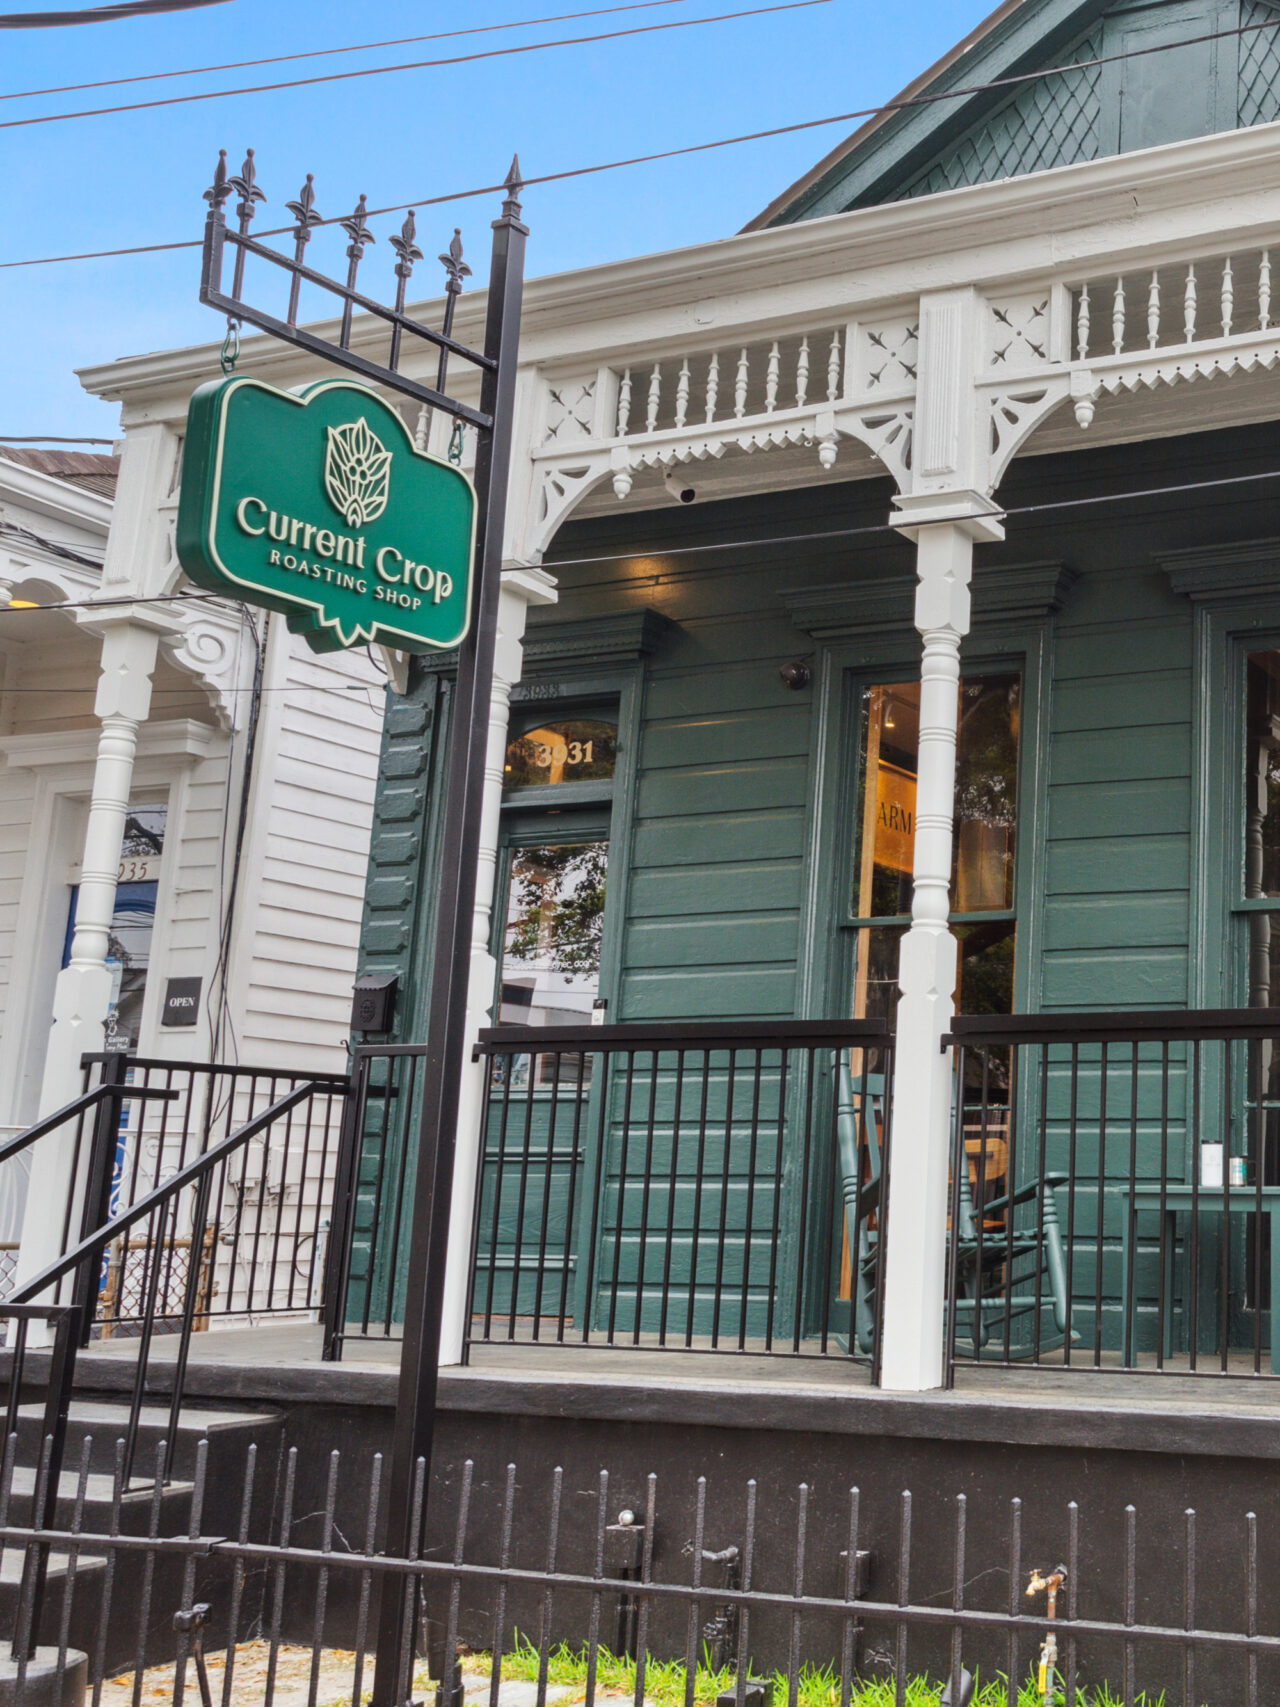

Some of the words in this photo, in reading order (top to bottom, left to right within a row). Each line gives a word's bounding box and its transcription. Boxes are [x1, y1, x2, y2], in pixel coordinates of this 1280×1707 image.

[236, 497, 366, 569] Current
[375, 546, 453, 603] Crop
[269, 549, 367, 593] ROASTING
[374, 585, 422, 610] SHOP
[537, 741, 593, 767] 3931
[169, 997, 195, 1007] OPEN
